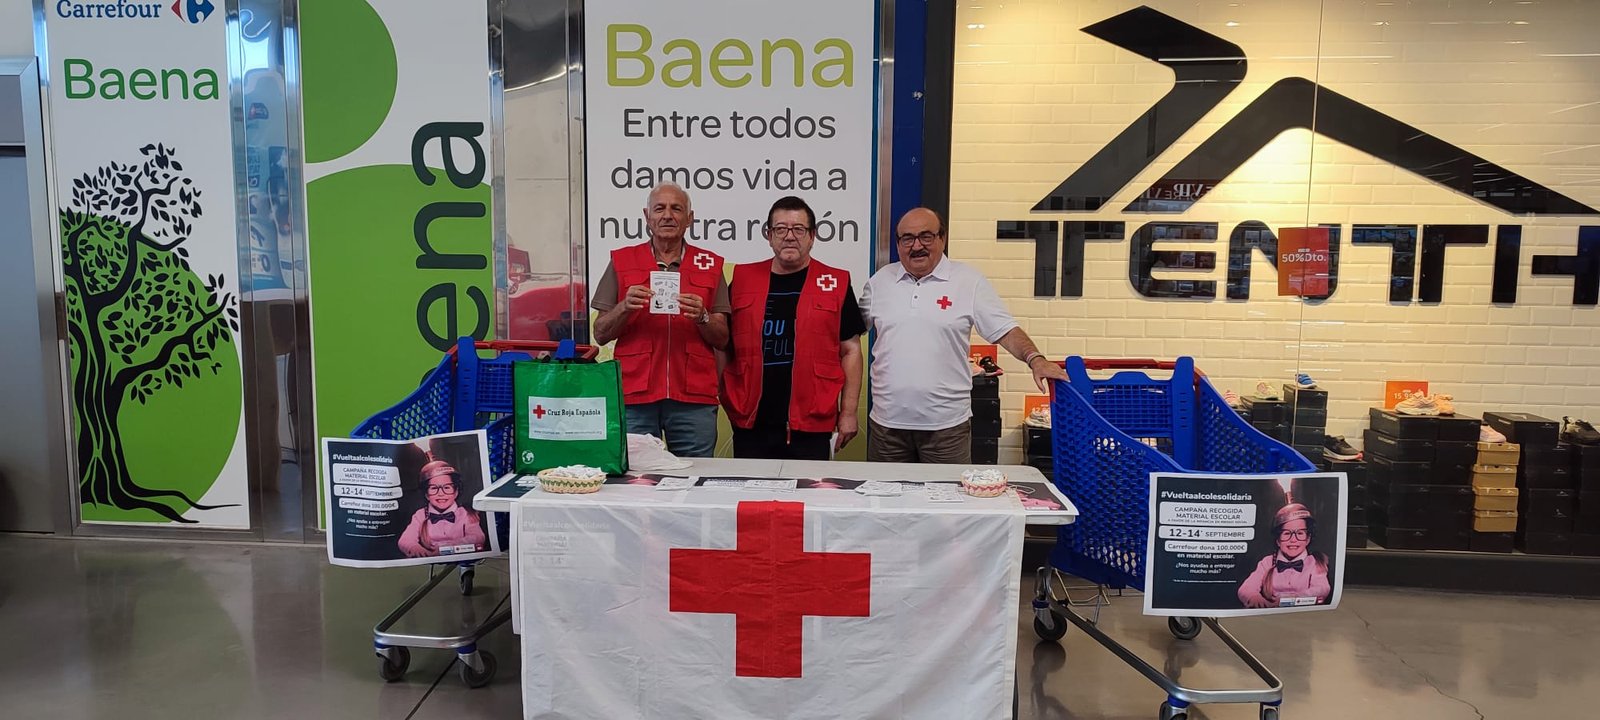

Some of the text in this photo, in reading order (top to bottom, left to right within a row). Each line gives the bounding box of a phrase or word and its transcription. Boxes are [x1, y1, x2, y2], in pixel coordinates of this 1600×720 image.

[56, 0, 162, 18] Carrefour
[607, 24, 854, 88] Baena
[64, 59, 219, 100] Baena
[624, 107, 836, 138] Entre todos
[611, 159, 847, 190] damos vida a
[600, 217, 736, 241] nutra
[997, 220, 1600, 305] TENTH
[561, 409, 574, 418] Roja
[575, 409, 601, 418] Española
[1161, 491, 1252, 501] #Vueltaalcolesolidaria
